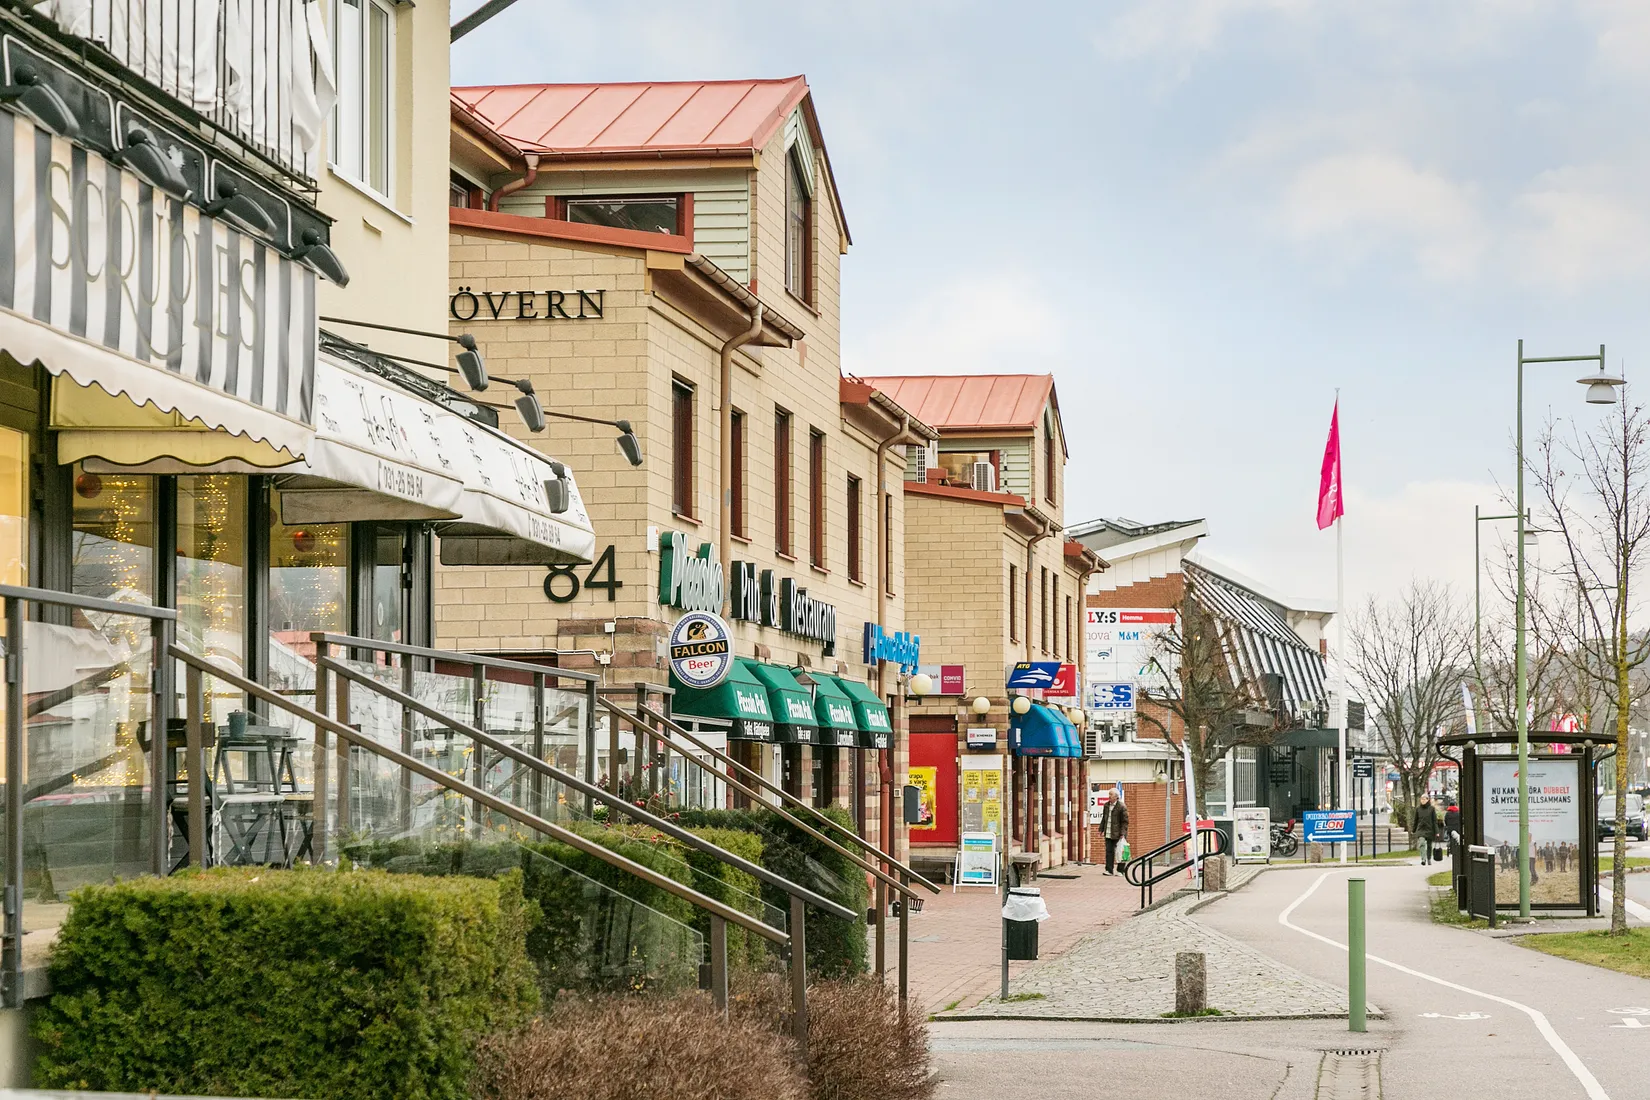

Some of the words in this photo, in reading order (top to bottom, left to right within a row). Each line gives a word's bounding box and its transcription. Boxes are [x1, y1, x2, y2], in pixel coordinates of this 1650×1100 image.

[46, 160, 258, 360] SCRUPLES
[543, 544, 623, 603] 84
[664, 530, 724, 615] Piccolo
[735, 560, 761, 623] Pub
[765, 569, 781, 629] &
[785, 578, 837, 657] Restaurang
[1118, 631, 1139, 640] M&M
[673, 641, 726, 657] FALCON
[688, 659, 714, 670] Beer
[1094, 684, 1131, 702] SS
[1492, 787, 1501, 795] NU
[1502, 787, 1515, 795] KAN
[1528, 785, 1541, 795] ÖRA
[1543, 786, 1570, 794] DUBBELT
[1491, 795, 1499, 804] SÅ
[1314, 820, 1345, 830] ELON
